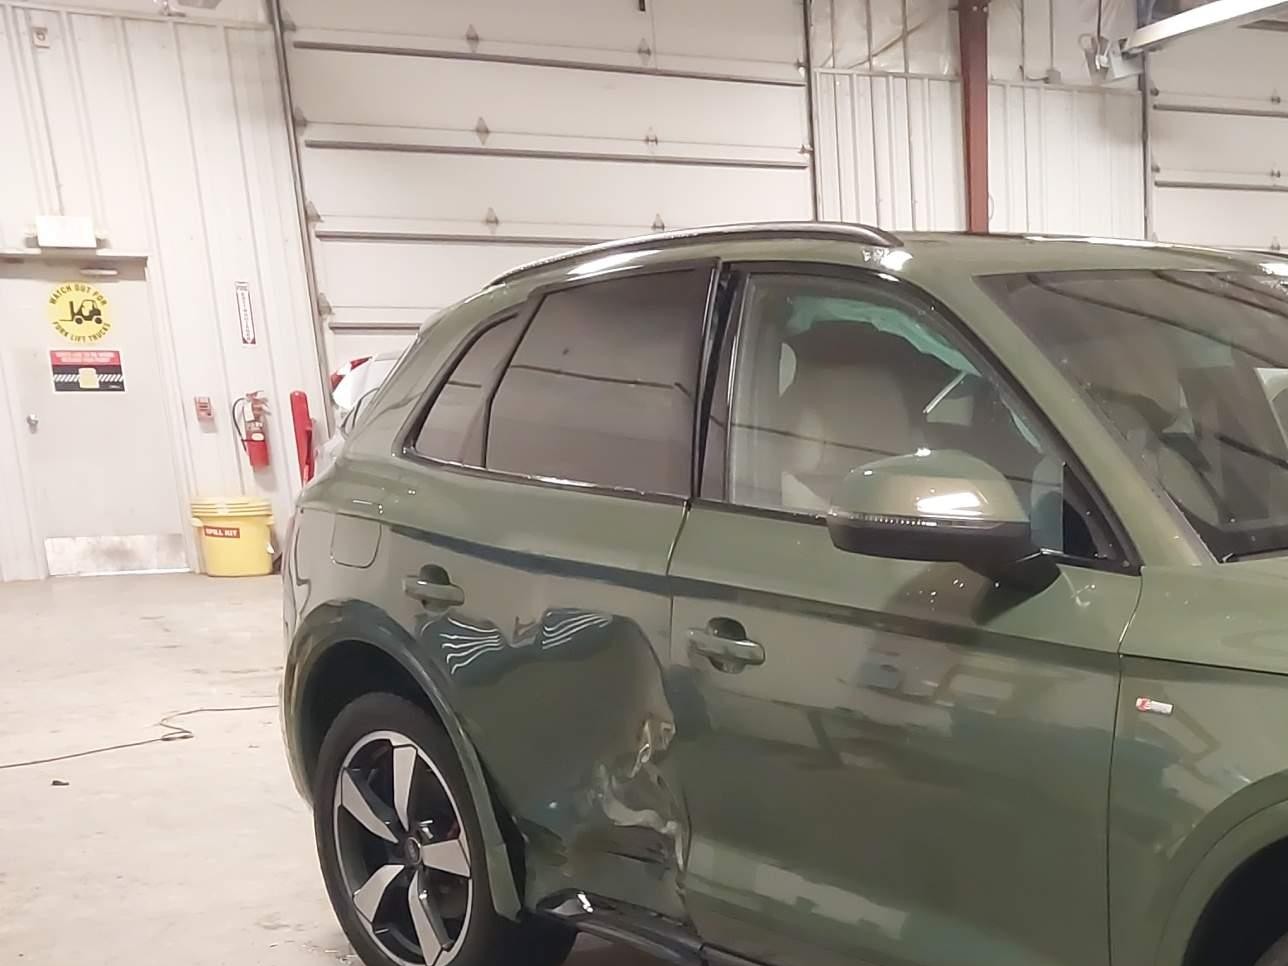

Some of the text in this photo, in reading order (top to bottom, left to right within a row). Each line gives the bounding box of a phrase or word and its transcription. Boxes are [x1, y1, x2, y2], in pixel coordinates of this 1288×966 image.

[49, 284, 107, 306] WATCH OUT FOR
[52, 321, 111, 342] FORK LIFT TRUCKS
[225, 529, 238, 537] KIT
